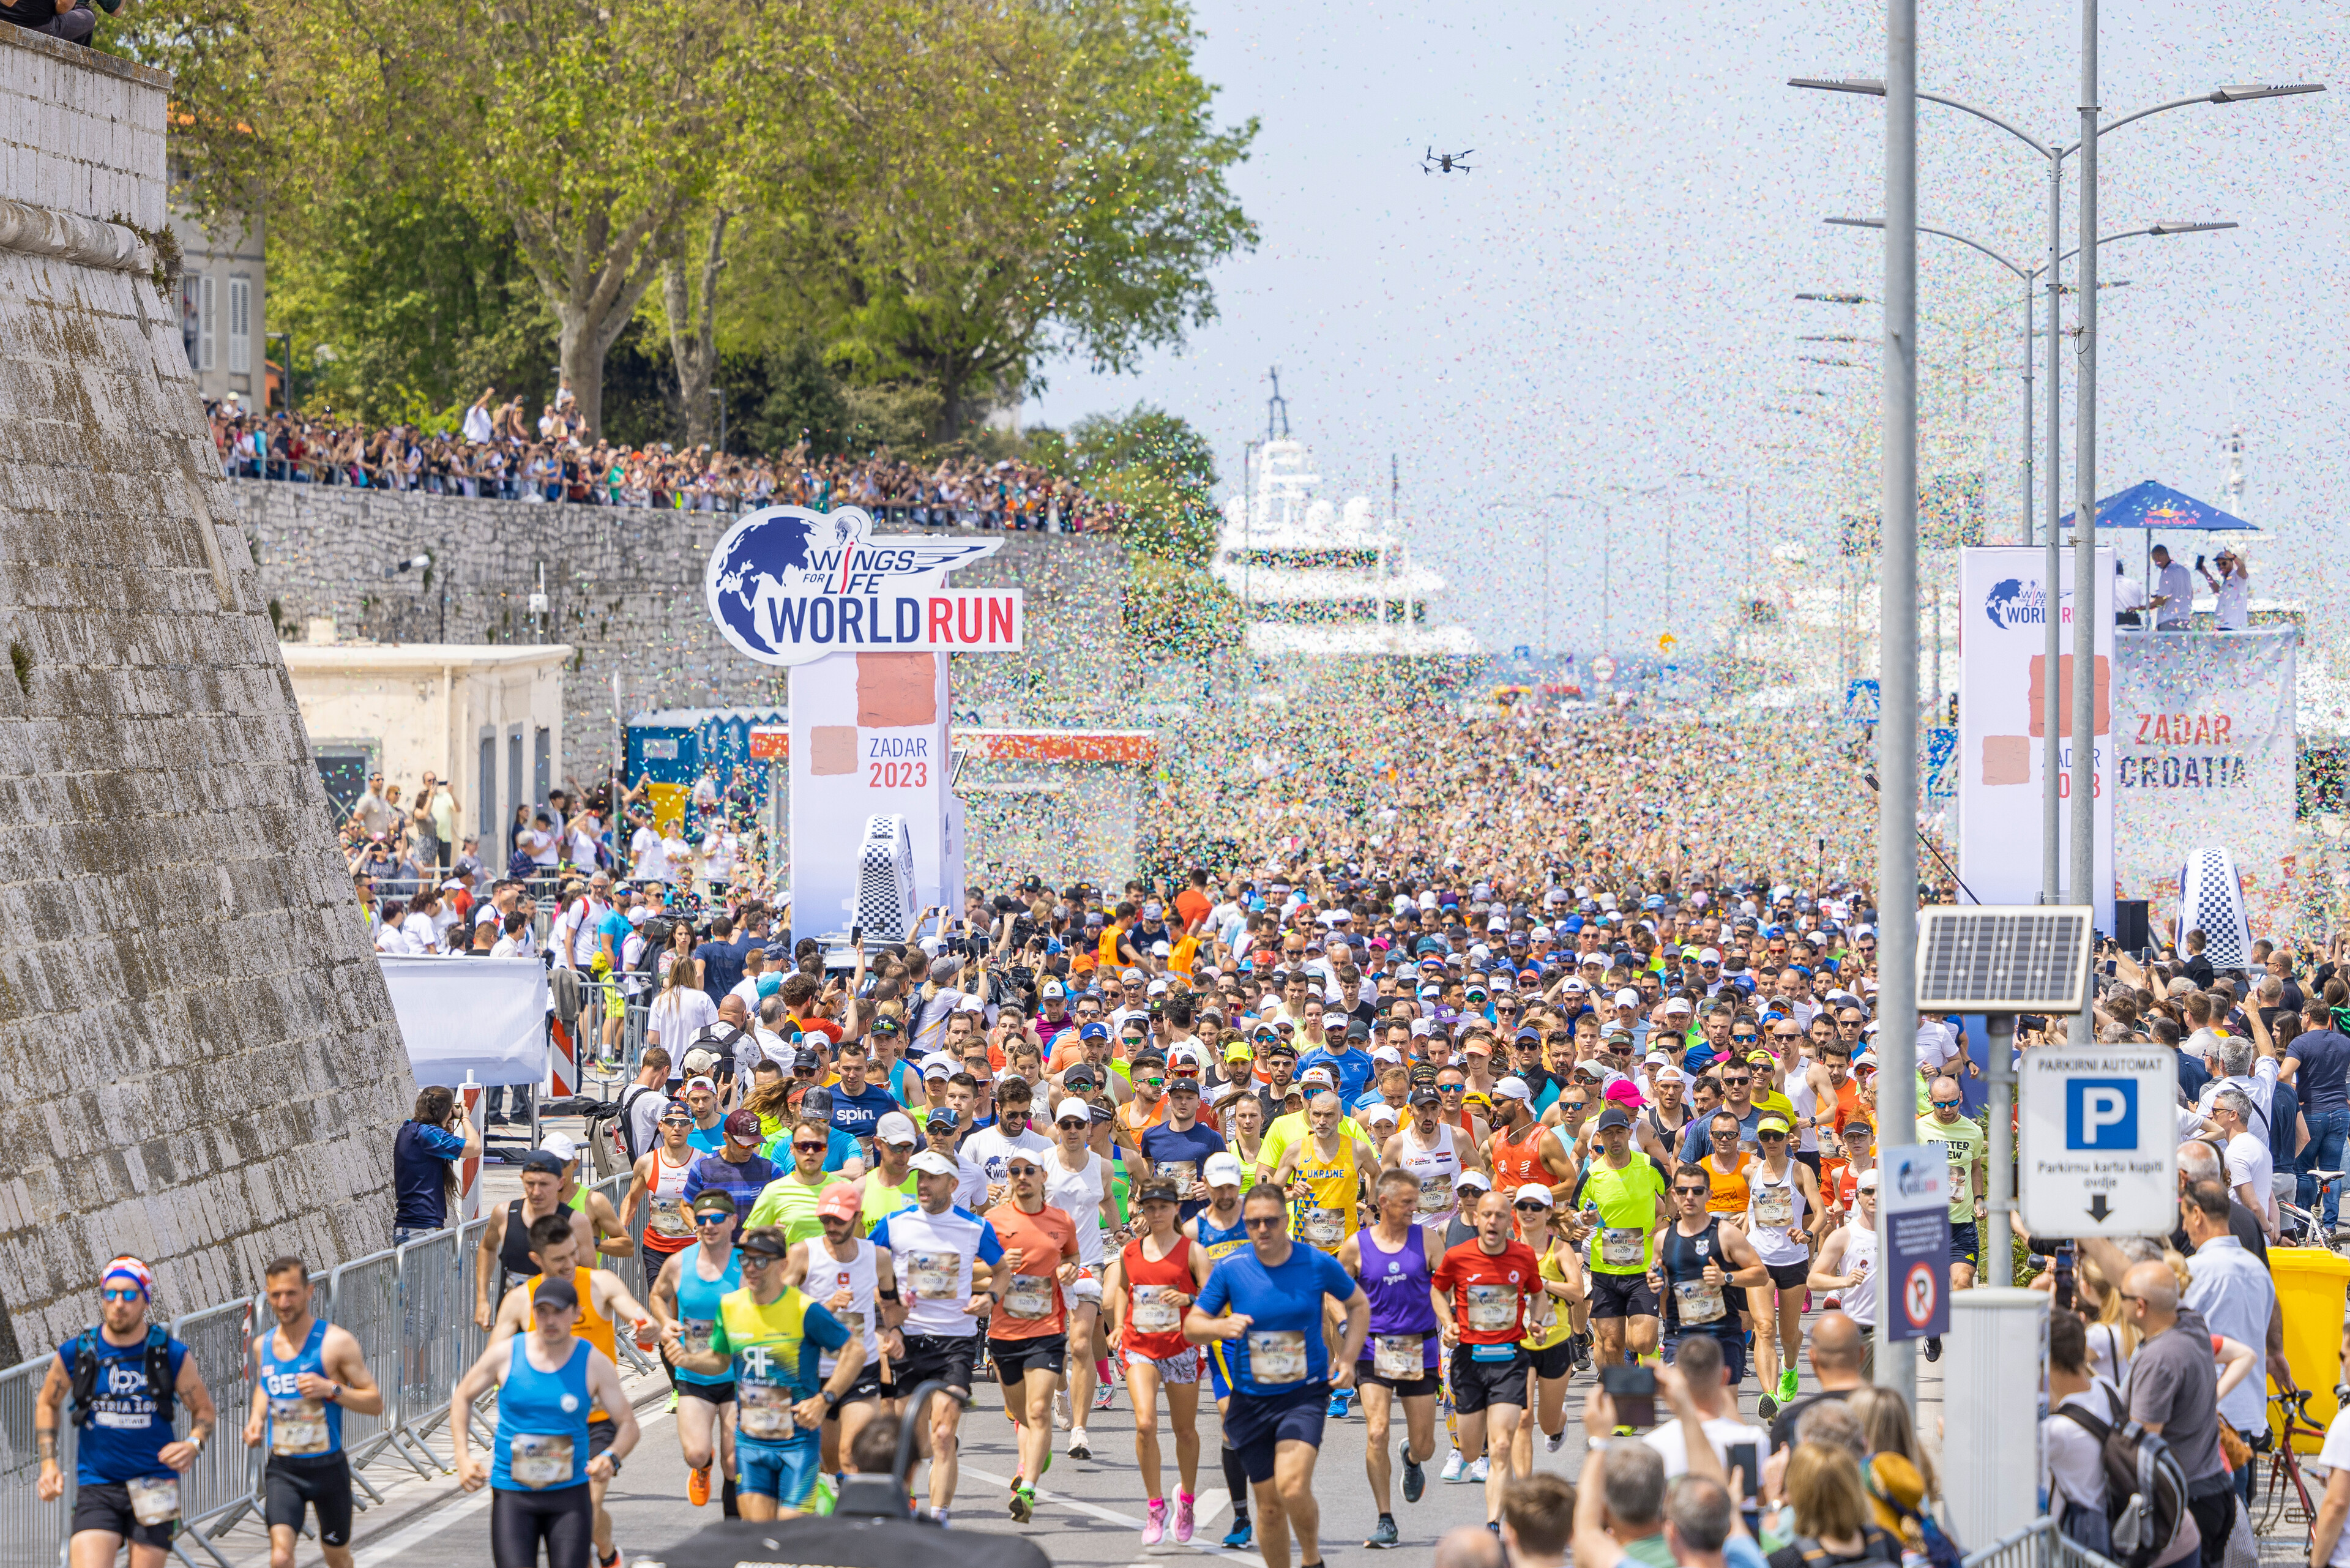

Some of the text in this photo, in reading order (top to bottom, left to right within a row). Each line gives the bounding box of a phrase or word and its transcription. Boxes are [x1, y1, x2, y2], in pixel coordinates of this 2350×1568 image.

[809, 542, 915, 571] WINGS
[802, 573, 825, 583] FOR
[822, 573, 884, 594] LIFE
[767, 597, 1013, 643] WORLD RUN
[2135, 714, 2232, 745] ZADAR
[870, 738, 928, 757] ZADAR
[869, 761, 927, 788] 2023
[2120, 756, 2249, 788] CROATIA
[2038, 1058, 2163, 1072] PARKIRNI AUTOMAT
[836, 1107, 876, 1125] spin.
[2082, 1087, 2127, 1144] P
[1307, 1169, 1345, 1179] UKRAINE
[90, 1400, 132, 1413] STRIA
